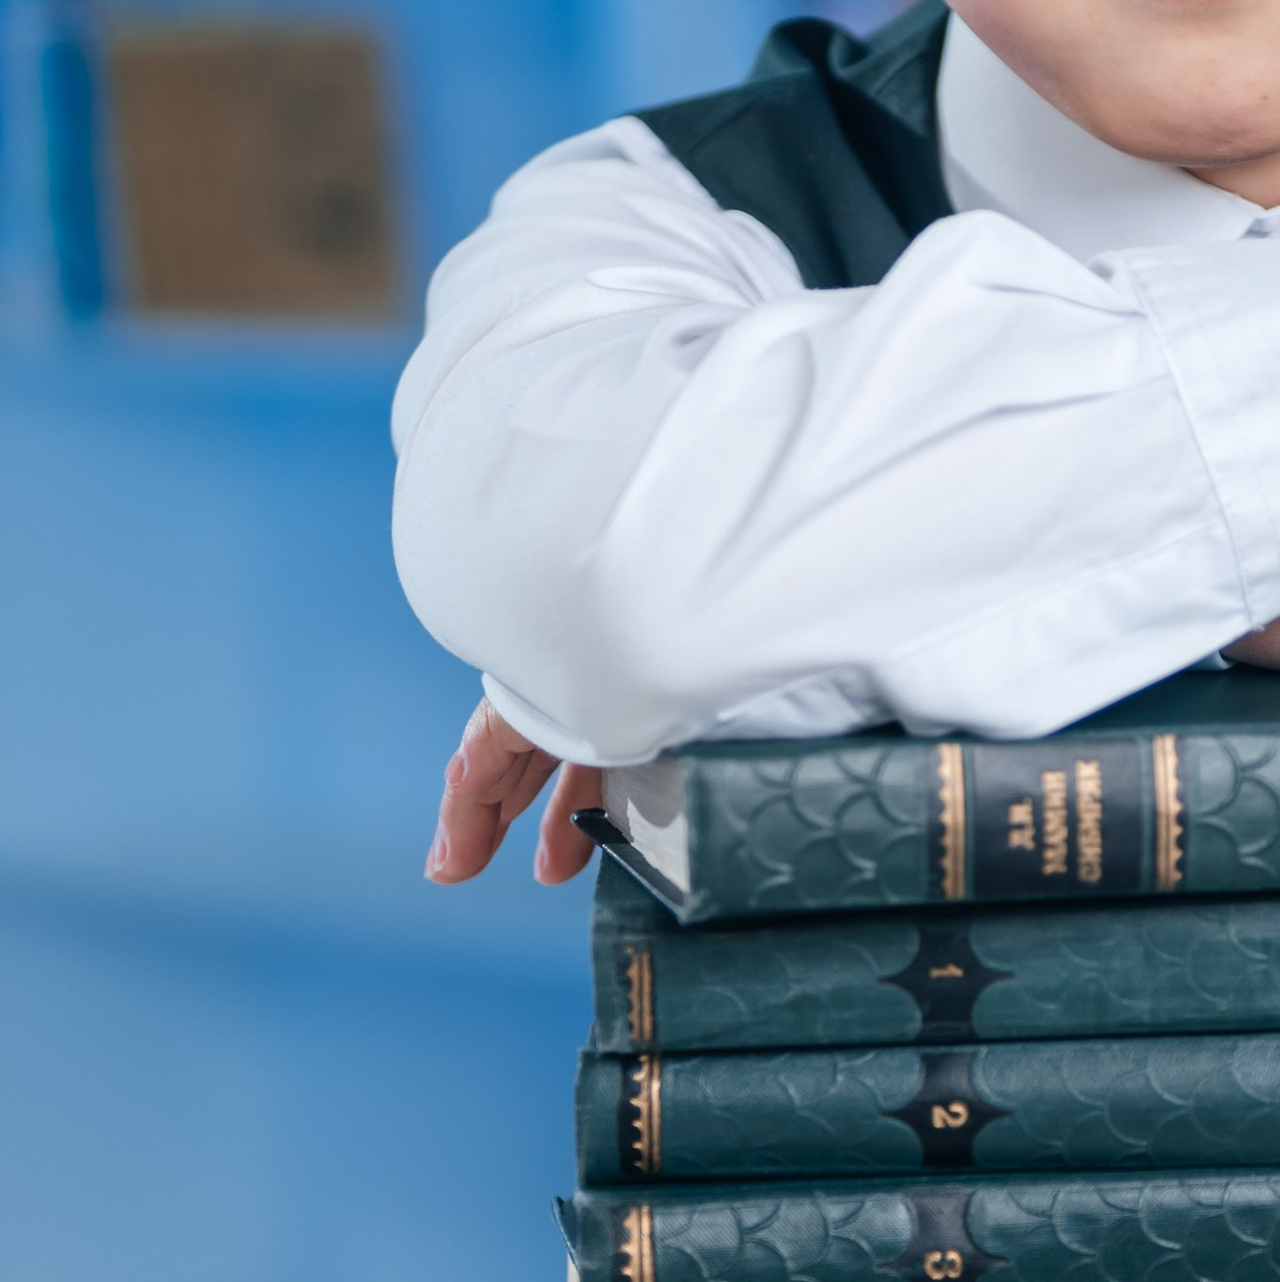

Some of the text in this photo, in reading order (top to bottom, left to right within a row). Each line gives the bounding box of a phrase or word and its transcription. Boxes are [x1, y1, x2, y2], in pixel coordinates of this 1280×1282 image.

[931, 963, 963, 980] 1
[931, 1101, 969, 1128] 2
[924, 1249, 963, 1280] 3
